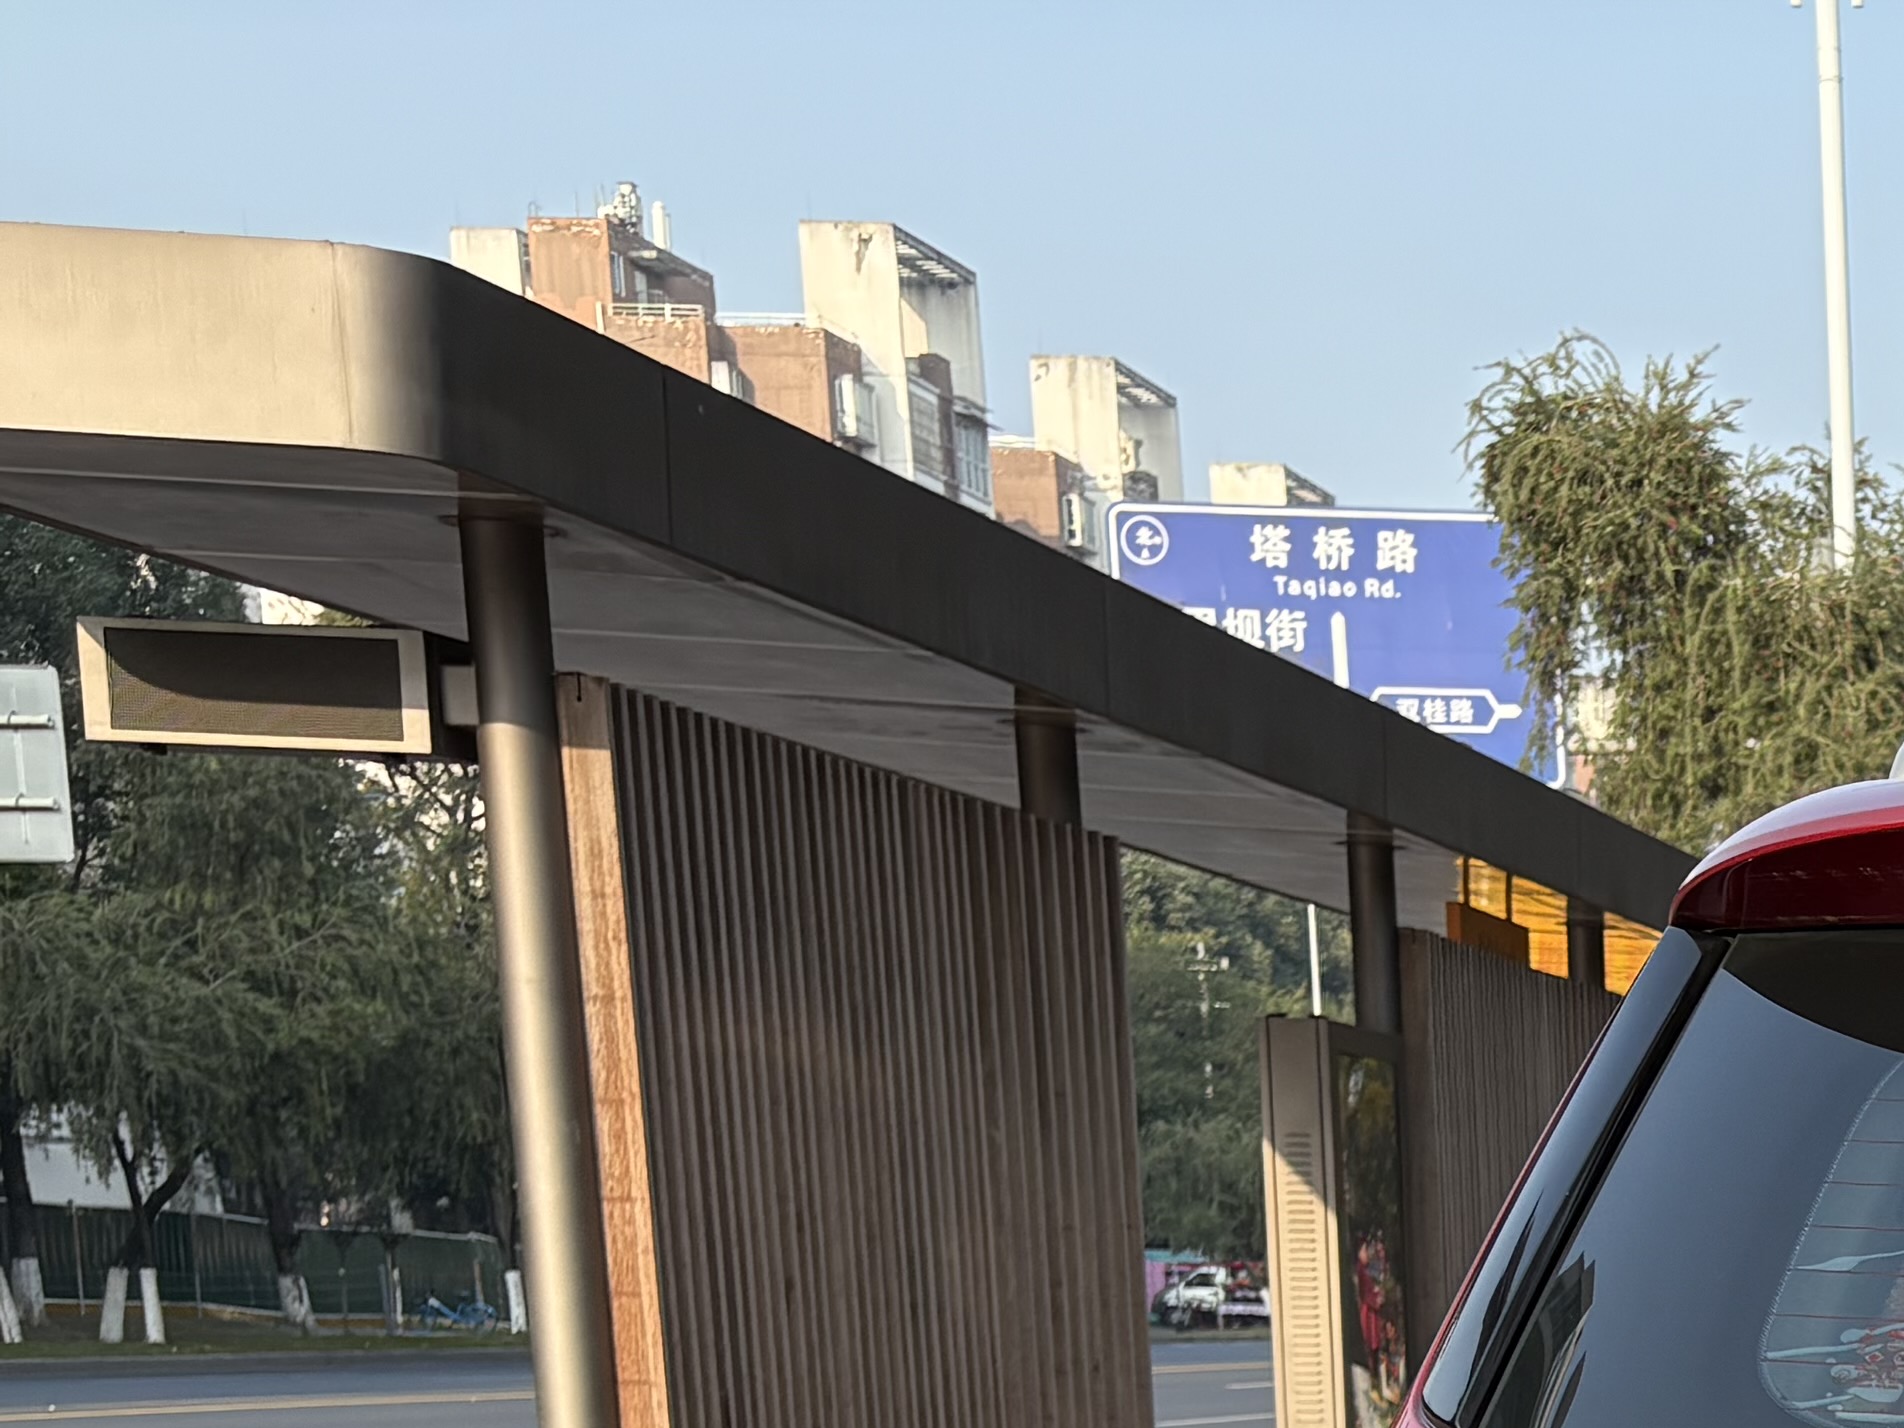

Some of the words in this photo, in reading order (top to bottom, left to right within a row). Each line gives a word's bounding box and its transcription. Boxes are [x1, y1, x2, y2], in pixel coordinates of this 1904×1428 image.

[1249, 524, 1418, 573] 塔桥路
[1273, 575, 1357, 600] Taqiao
[1364, 578, 1402, 599] Rd.
